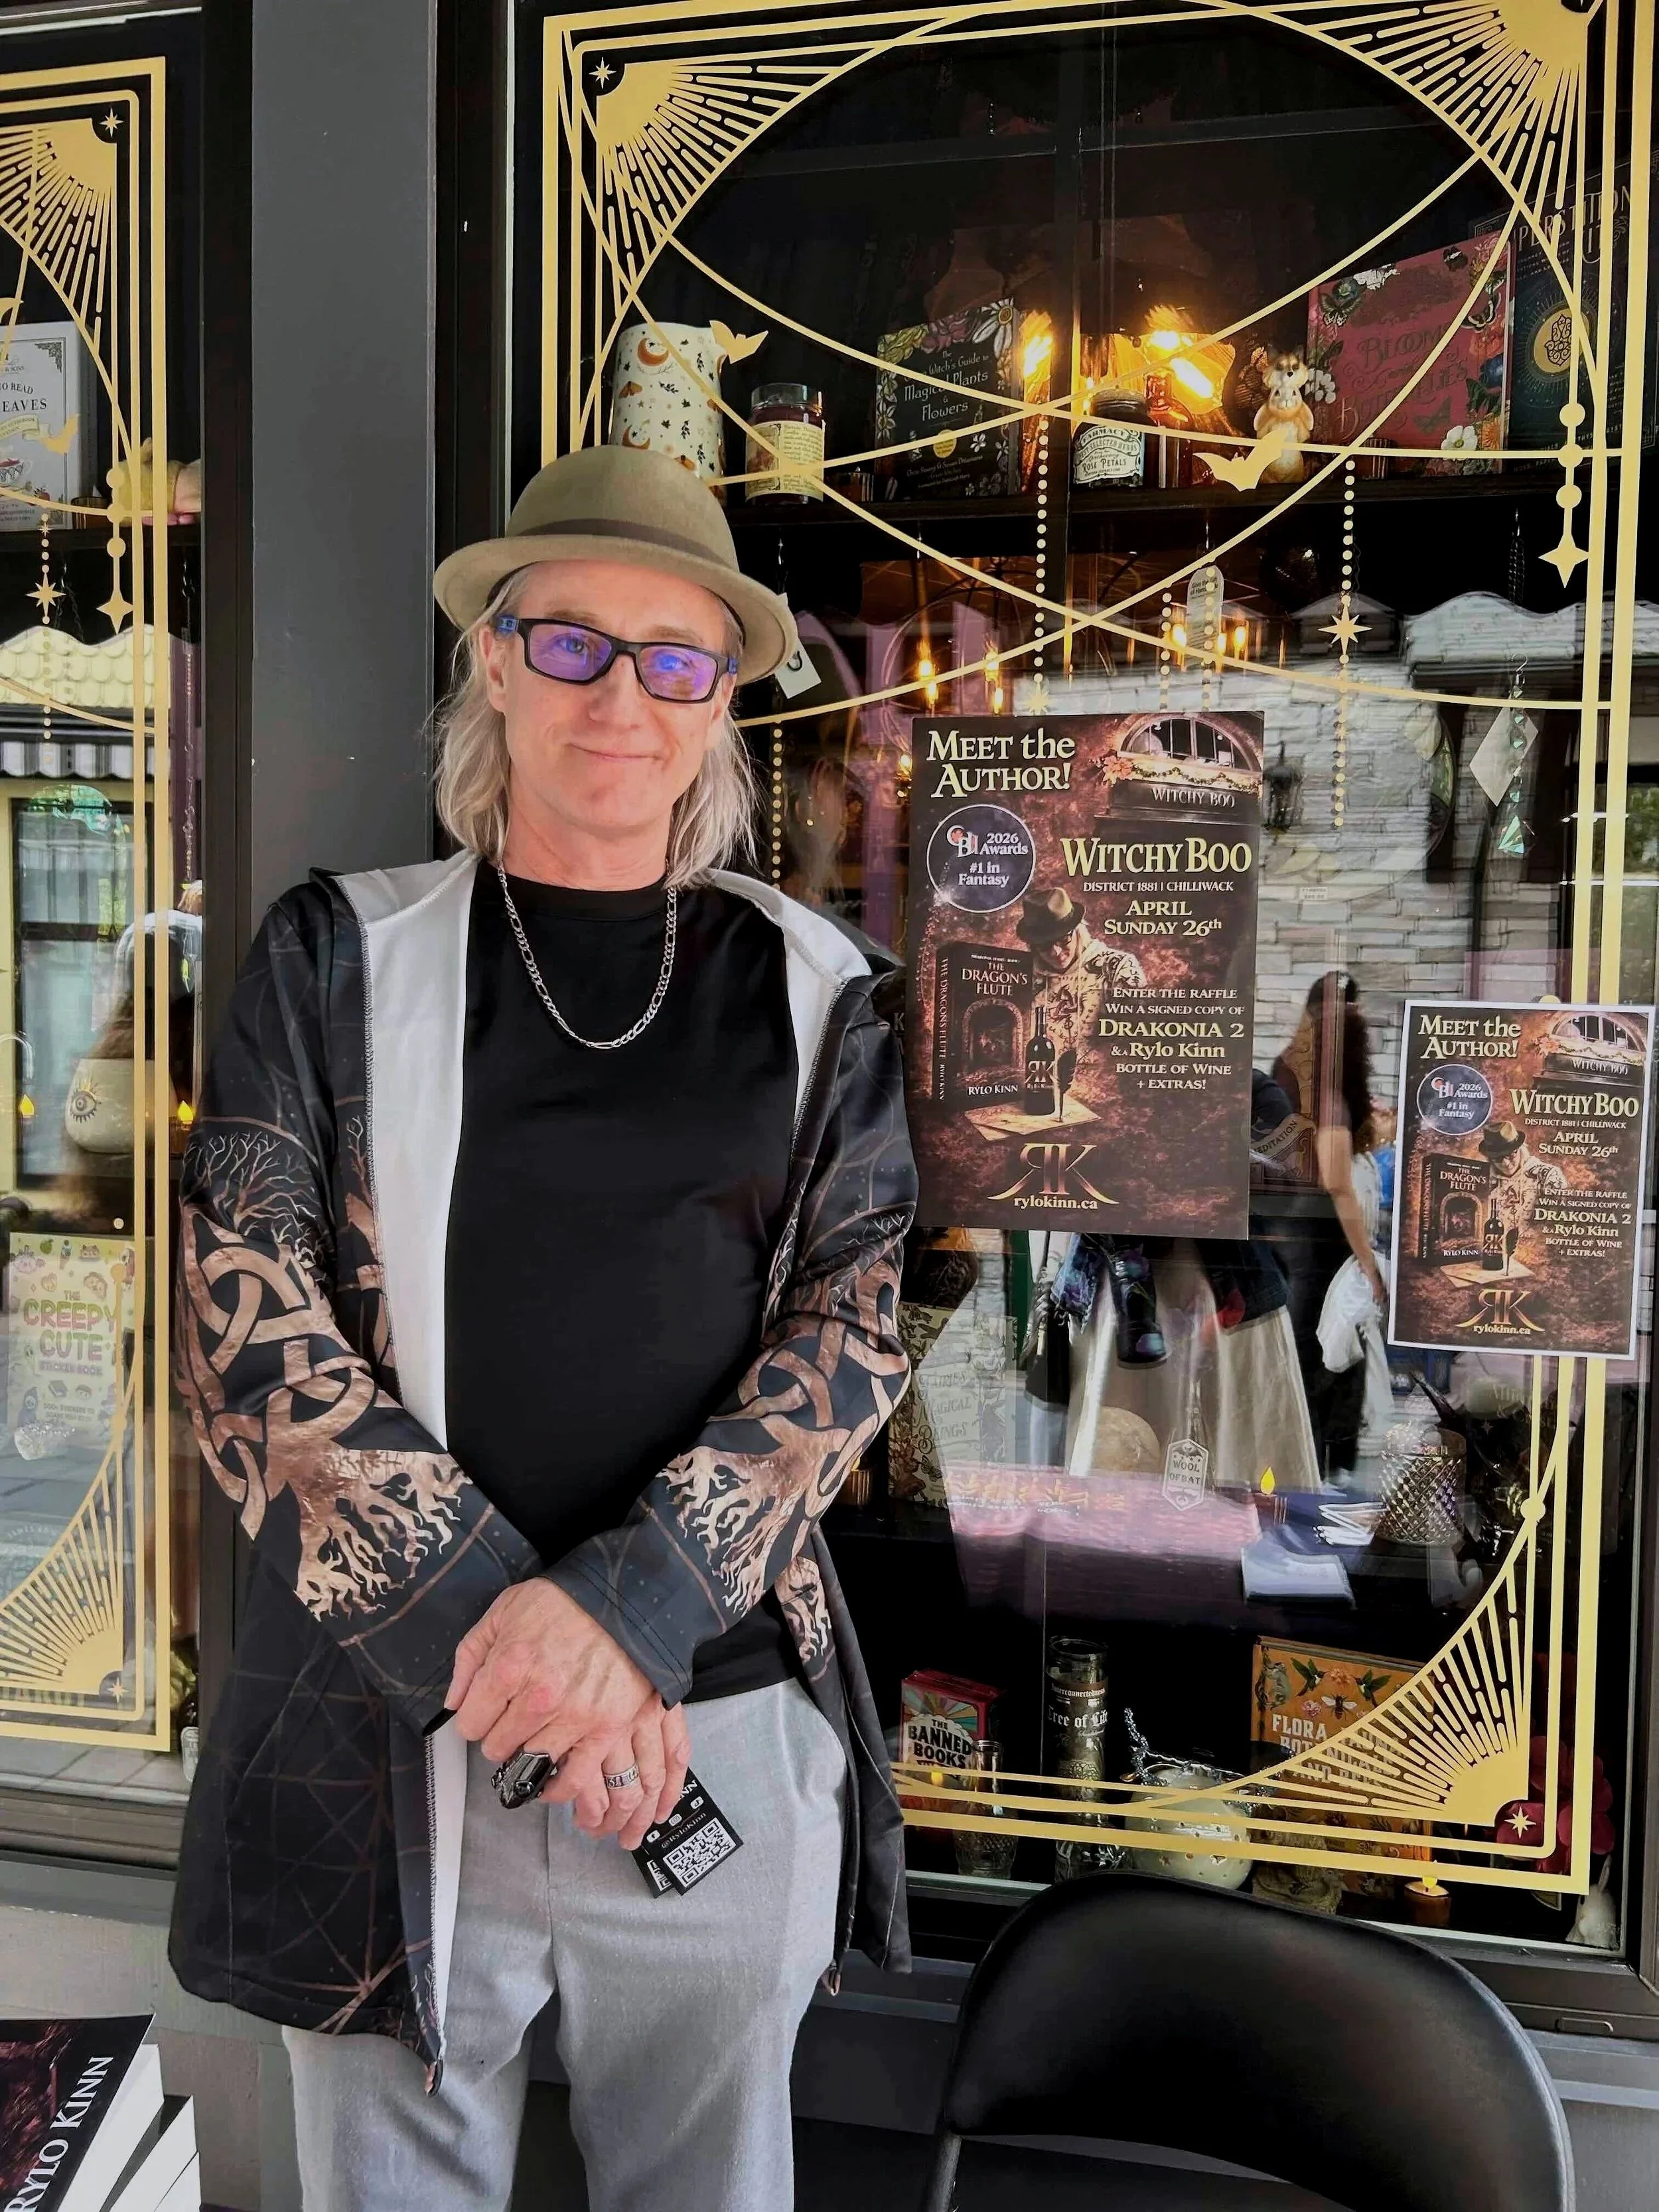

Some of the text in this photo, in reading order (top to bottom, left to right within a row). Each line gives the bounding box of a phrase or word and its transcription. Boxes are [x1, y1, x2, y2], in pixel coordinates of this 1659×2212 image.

[958, 353, 981, 366] Guide
[11, 382, 33, 394] READ
[2, 398, 47, 412] EAVES
[922, 402, 968, 421] Flowers
[1101, 459, 1127, 469] PETALS
[926, 727, 1076, 761] MEET the
[930, 763, 1071, 798] AUTHOR!
[1151, 786, 1235, 808] WITCHY BOO
[987, 833, 1019, 844] 2026
[979, 842, 1029, 855] Awards
[1060, 838, 1252, 877] WITCHY BOO
[970, 861, 1000, 874] #1 in
[958, 873, 1010, 888] Fantasy
[1083, 881, 1135, 892] DISTRICT
[1137, 882, 1157, 892] 1881
[1166, 881, 1234, 892] CHILLIWACK
[1125, 899, 1192, 917] APRIL
[1104, 918, 1222, 936] SUNDAY 26th
[987, 962, 1005, 972] THE
[962, 968, 1028, 986] DRAGON'S
[976, 982, 1013, 996] FLUTE
[1113, 987, 1238, 999] ENTER THE RAFFLE
[1105, 1003, 1133, 1014] WIN
[1135, 1005, 1145, 1014] A
[1147, 1005, 1192, 1015] SIGNED
[1098, 1019, 1244, 1038] DRAKONIA 2
[1418, 1015, 1522, 1038] MEET the
[1129, 1042, 1174, 1060] Rylo
[1178, 1043, 1225, 1058] Kinn
[1420, 1036, 1519, 1059] AUTHOR!
[1116, 1064, 1232, 1075] BOTTLE OF WINE
[1571, 1058, 1628, 1075] WITCHY BOO
[968, 1084, 1019, 1096] RYLO KINN
[1148, 1079, 1206, 1090] EXTRAS!
[1454, 1089, 1488, 1098] Awards
[1447, 1101, 1468, 1110] #1 in
[1510, 1088, 1639, 1118] WITCHY BOO
[1439, 1109, 1475, 1120] Fantasy
[1581, 1120, 1626, 1129] CHILLIWACK
[1553, 1131, 1599, 1143] APRIL
[1538, 1142, 1618, 1158] SUNDAY 26th
[1440, 1171, 1486, 1184] DRAGON'S
[1450, 1181, 1477, 1191] FLUTE
[1544, 1188, 1574, 1197] ENTER
[1014, 1195, 1098, 1209] rylokinn.ca
[1539, 1198, 1557, 1207] WIN
[1534, 1208, 1631, 1224] DRAKONIA 2
[1554, 1224, 1585, 1237] Rylo
[1587, 1226, 1619, 1237] Kinn
[1546, 1238, 1579, 1246] BOTTLE
[1597, 1239, 1623, 1248] WINE
[1443, 1248, 1461, 1257] RYLO
[1567, 1249, 1606, 1258] EXTRAS!
[24, 1298, 115, 1333] CREEPY
[1473, 1324, 1531, 1335] rylokinn.ca
[40, 1329, 102, 1361] CUTE
[1173, 1460, 1199, 1472] WOOL
[1169, 1472, 1200, 1484] OF BAT
[932, 1719, 948, 1730] THE
[1074, 1714, 1088, 1728] of
[1272, 1714, 1327, 1740] FLORA
[908, 1726, 972, 1755] BANNED
[914, 1742, 966, 1769] BOOKS
[3, 2057, 114, 2212] RYLO KINN
